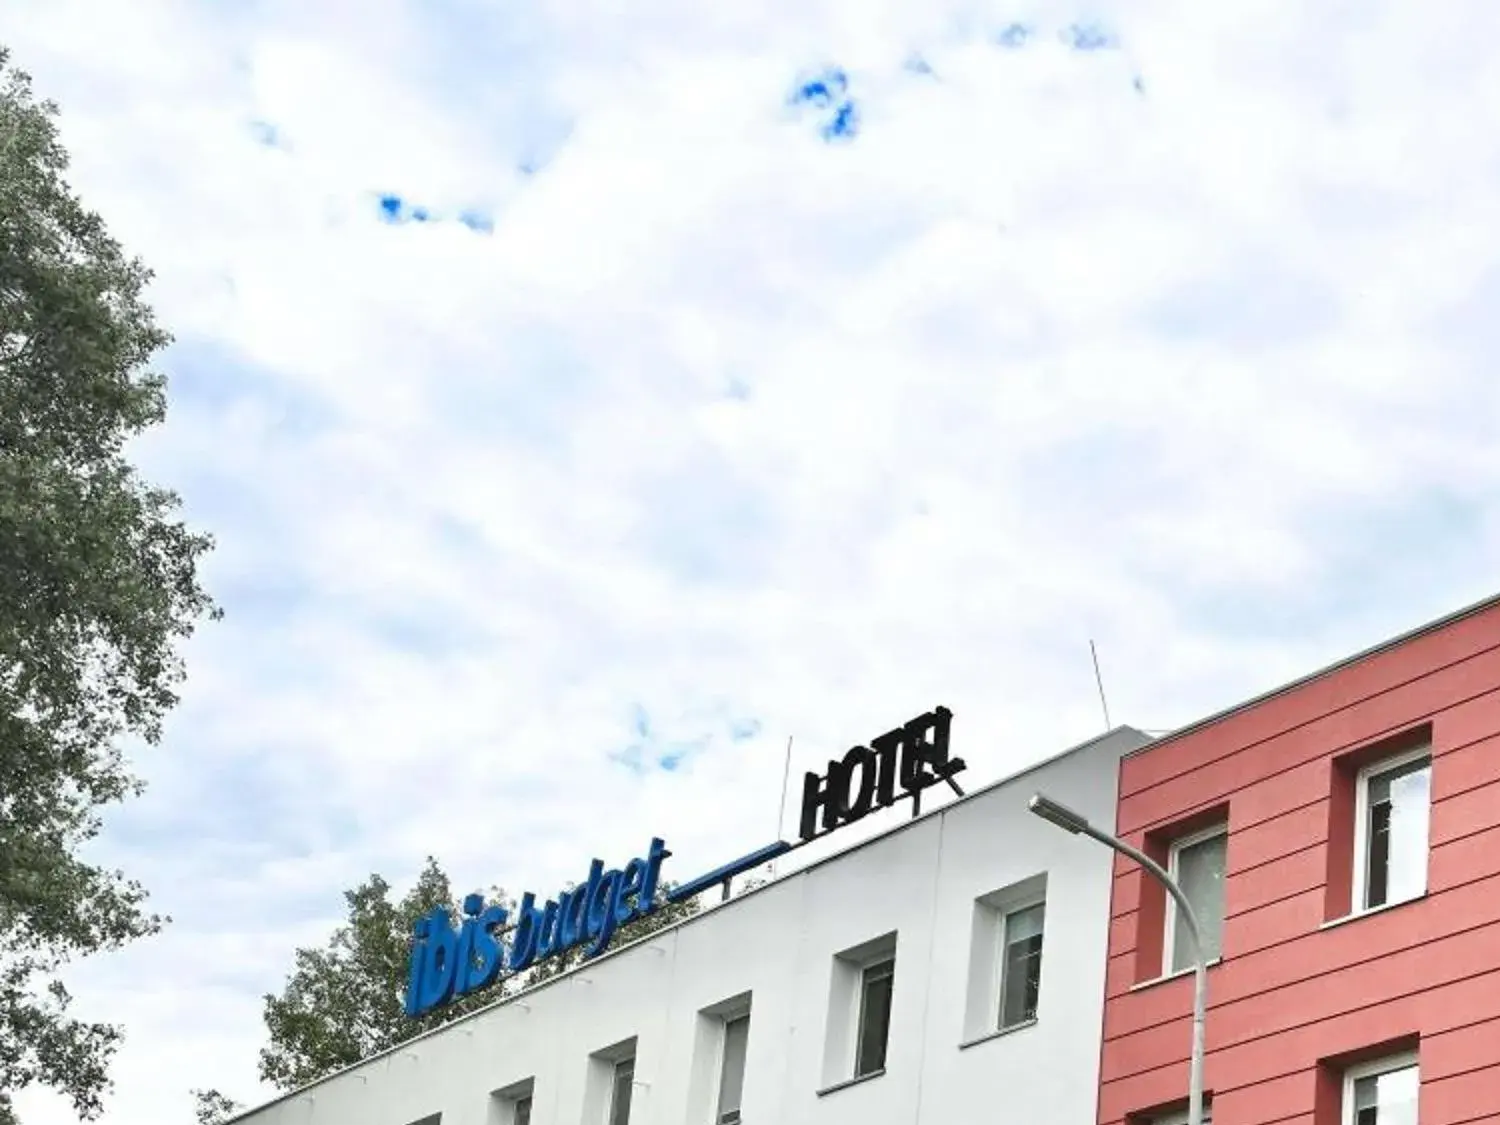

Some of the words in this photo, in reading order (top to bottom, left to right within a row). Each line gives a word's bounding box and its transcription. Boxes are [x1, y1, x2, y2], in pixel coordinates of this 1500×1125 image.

[405, 893, 508, 1018] ibis
[509, 836, 672, 971] budget
[799, 706, 966, 841] HOTEL
